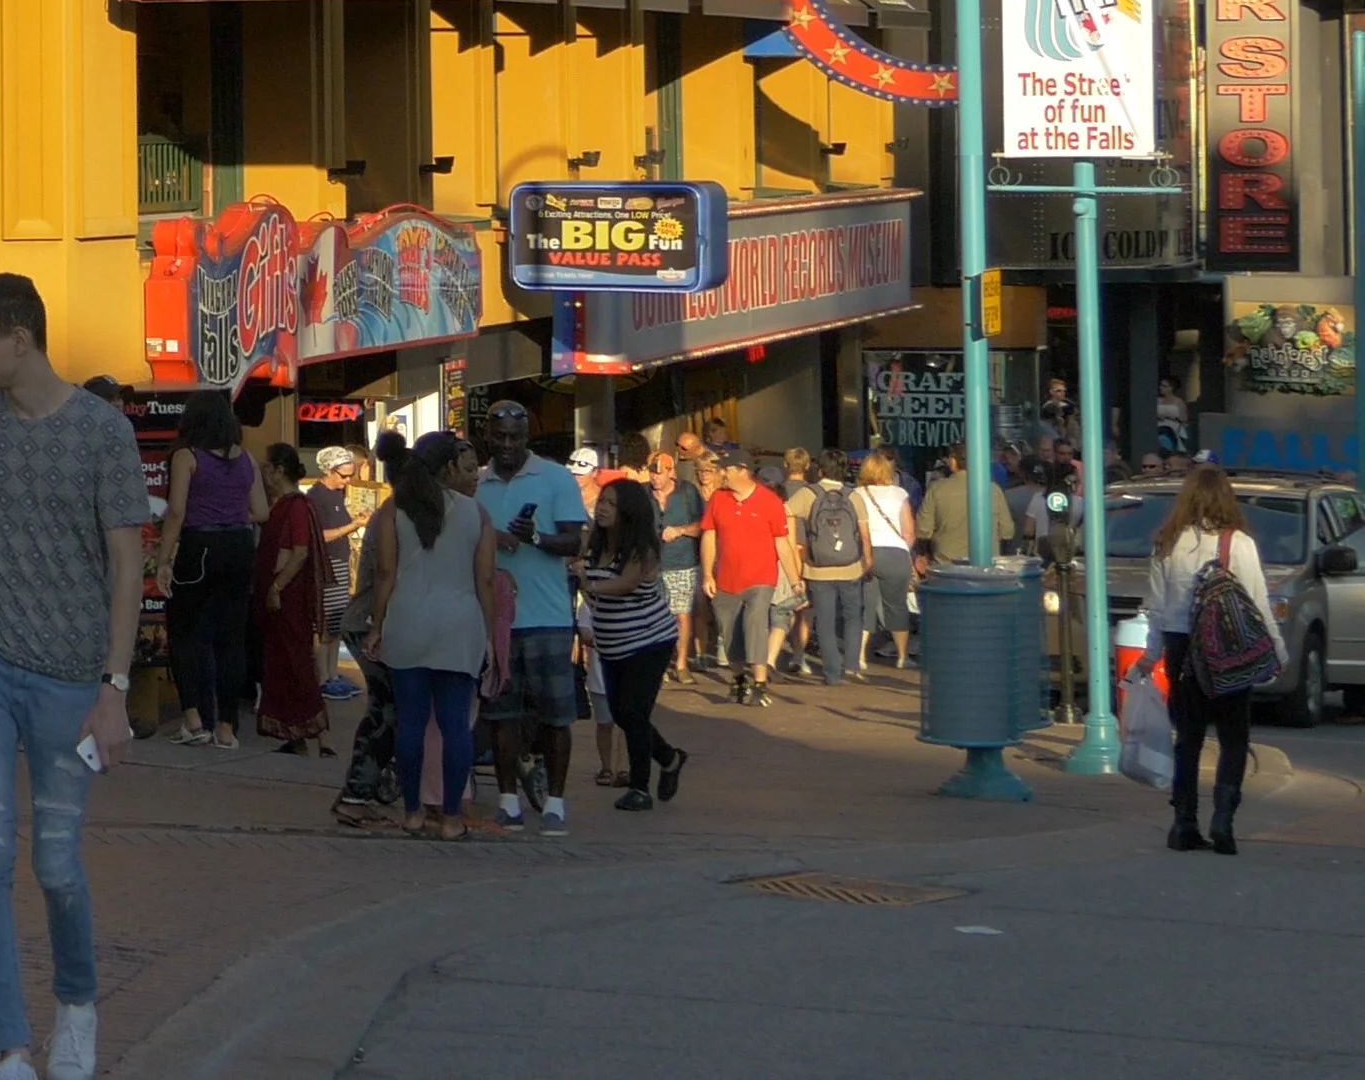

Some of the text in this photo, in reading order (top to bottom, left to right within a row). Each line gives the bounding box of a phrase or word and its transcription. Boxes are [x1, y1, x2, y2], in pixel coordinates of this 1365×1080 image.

[1019, 71, 1130, 97] The Stree
[1044, 99, 1106, 123] of fun
[1017, 126, 1135, 151] at the Falls
[1217, 36, 1289, 254] STORE
[545, 211, 572, 220] Exciting
[614, 211, 630, 219] One
[631, 211, 649, 219] LOW
[526, 220, 683, 251] The BIG Fun
[1049, 232, 1077, 261] IC
[548, 252, 662, 267] VALUE PASS
[724, 234, 779, 315] WORLD
[781, 225, 845, 305] RECORDS
[845, 219, 904, 292] MUSEUM
[238, 213, 298, 357] Gifts
[124, 401, 186, 417] ubyTues
[298, 401, 362, 421] OPEN
